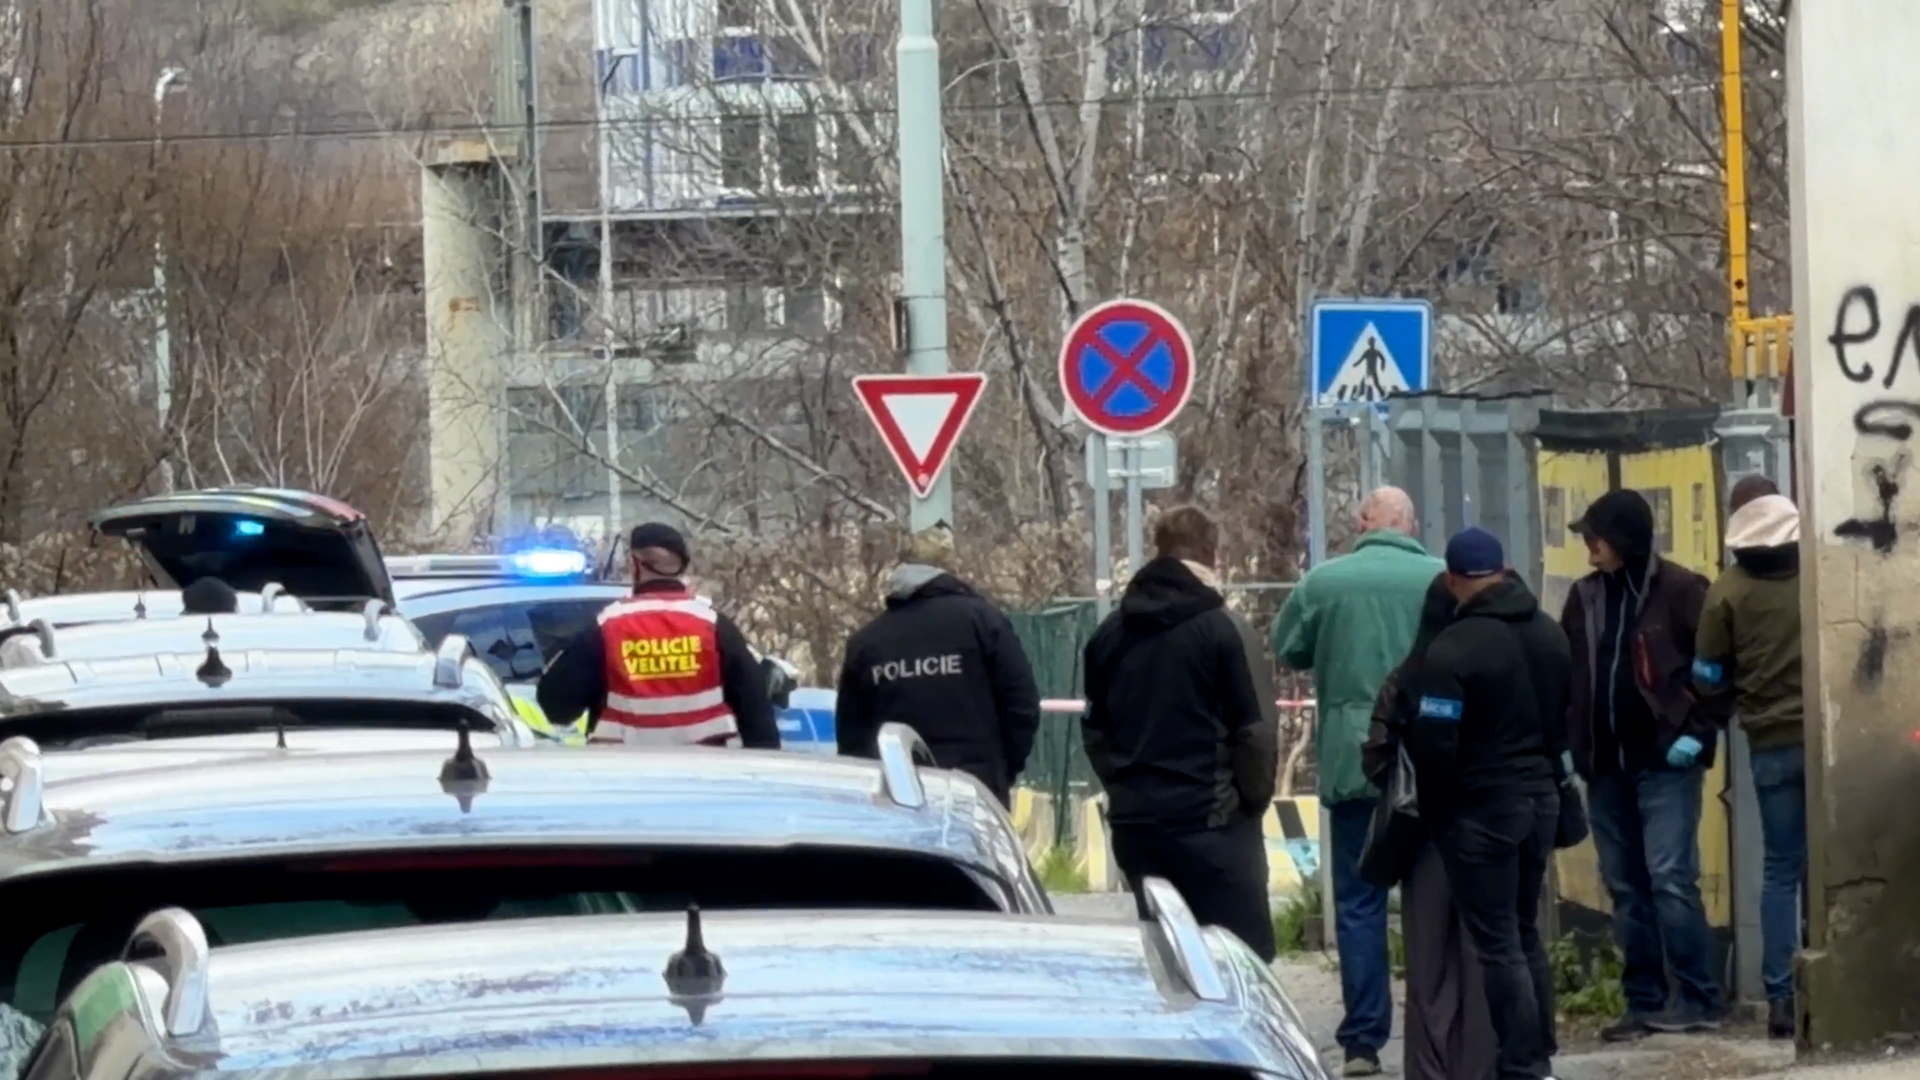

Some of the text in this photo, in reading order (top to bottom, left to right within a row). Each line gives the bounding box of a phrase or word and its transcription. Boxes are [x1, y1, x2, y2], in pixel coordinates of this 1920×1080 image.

[621, 635, 702, 658] POLICIE
[623, 654, 701, 675] VELITEL
[871, 654, 962, 686] POLICIE
